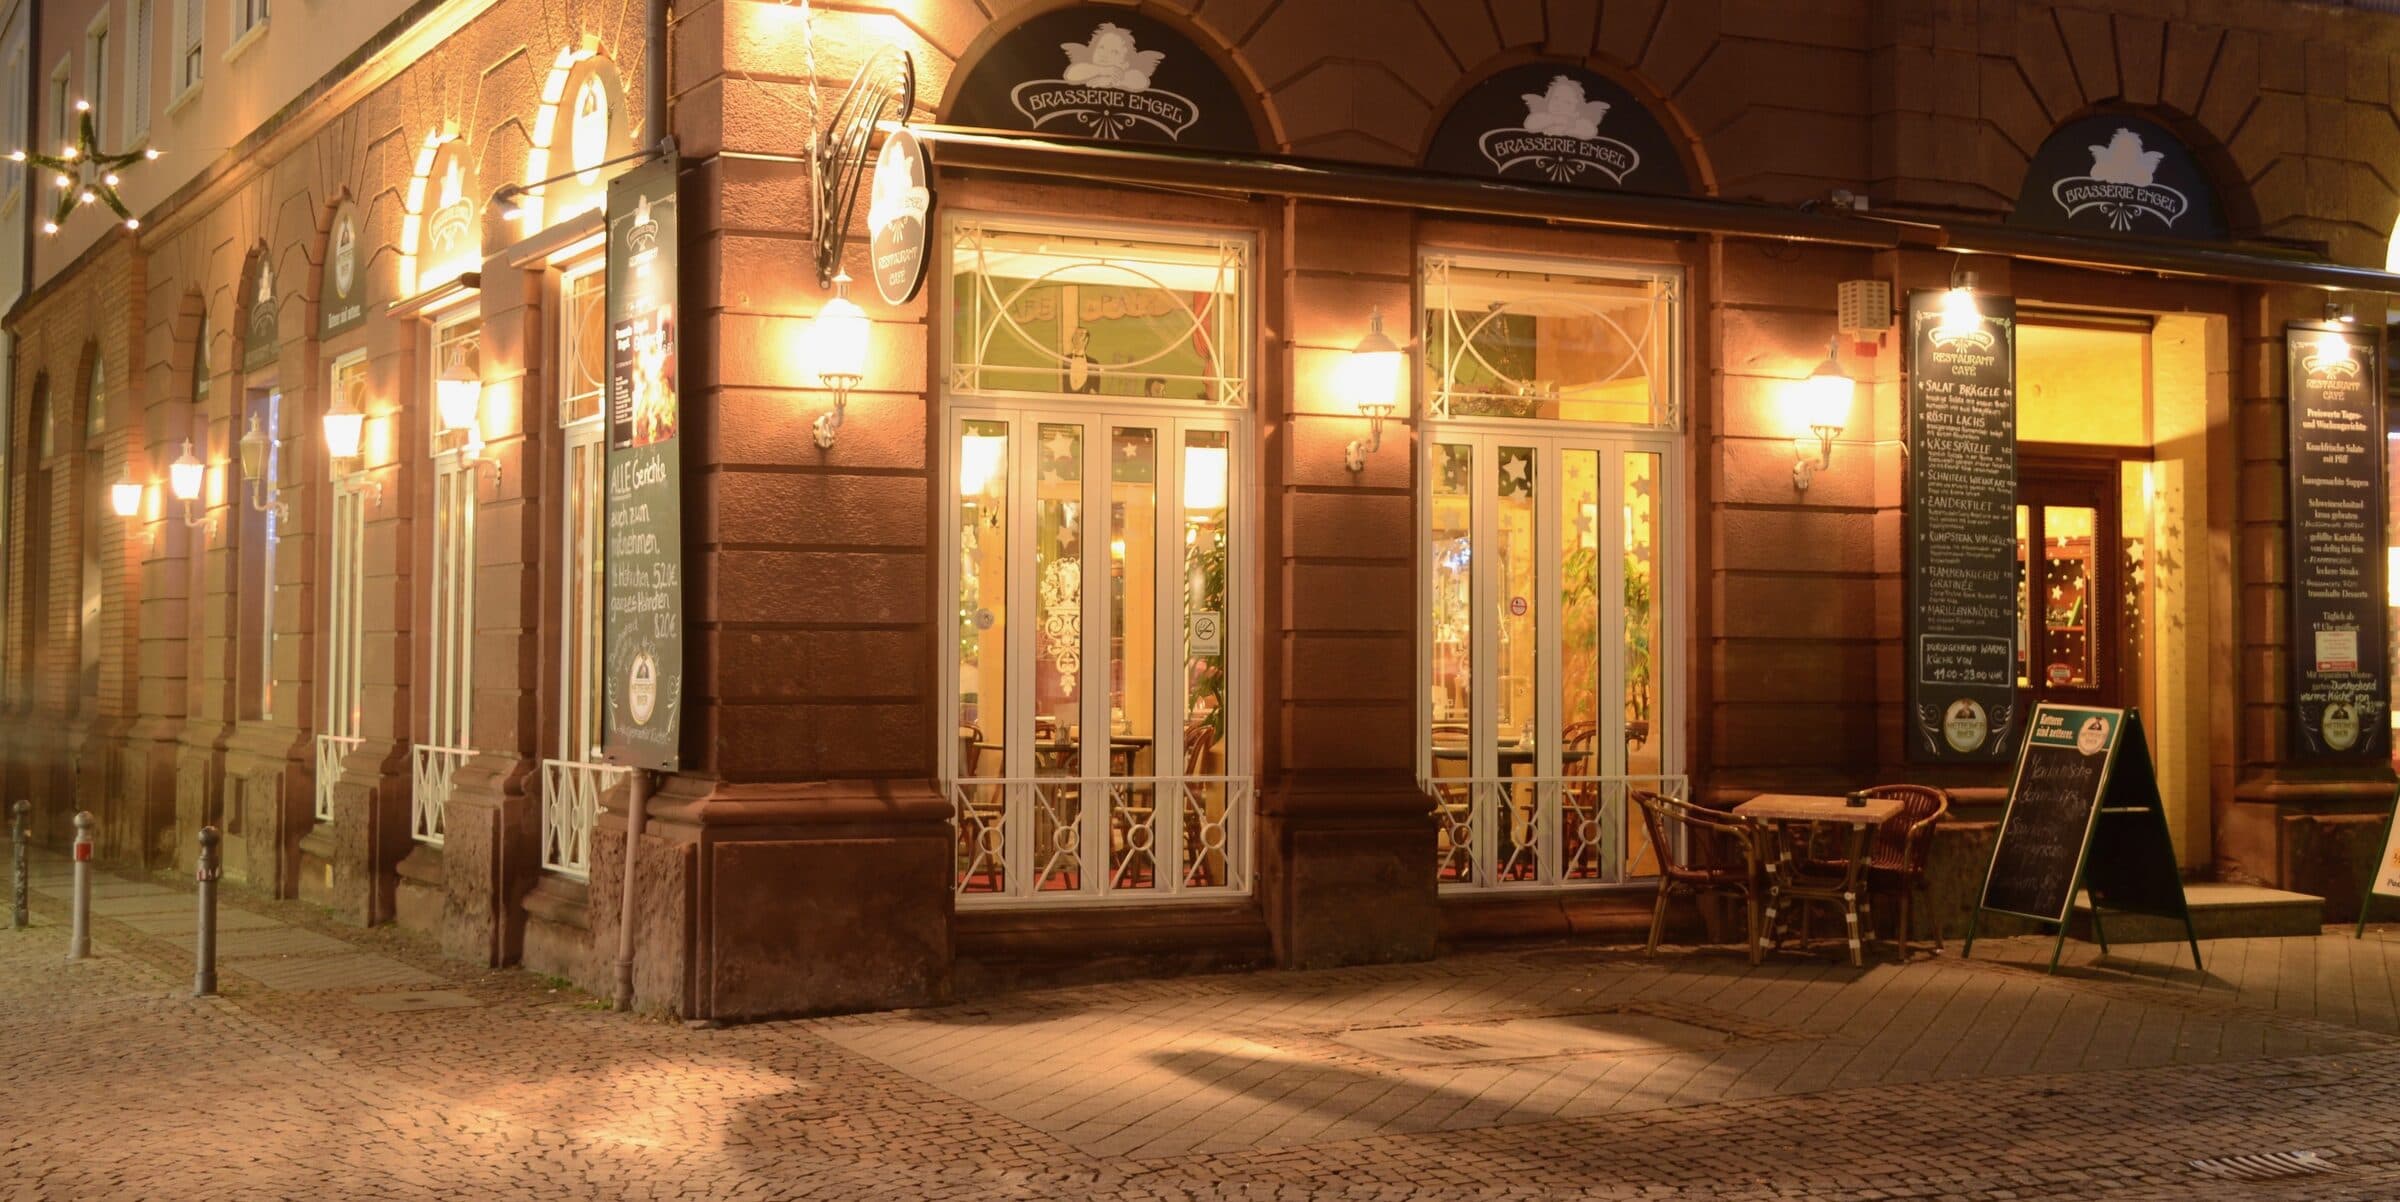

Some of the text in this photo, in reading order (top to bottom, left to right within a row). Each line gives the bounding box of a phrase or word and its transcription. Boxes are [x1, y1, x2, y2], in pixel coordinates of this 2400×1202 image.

[1029, 89, 1183, 124] BRASSERIE ENGEL
[1494, 137, 1626, 169] BRASSERIE ENGEL
[2065, 185, 2176, 213] BRASSERIE ENGEL
[1932, 352, 1995, 367] RESTAURANT
[1925, 379, 1955, 393] SALAT
[1959, 383, 2000, 397] BRÄGELE
[2306, 379, 2361, 392] RESTAURANT
[1926, 410, 1953, 424] RÖSTI
[1956, 415, 1986, 428] LACHS
[2302, 419, 2316, 429] und
[611, 453, 666, 495] ALLE Gerichte
[2346, 477, 2369, 489] Suppen
[1928, 496, 1993, 511] ZANDERFILET
[611, 503, 650, 528] auch zum
